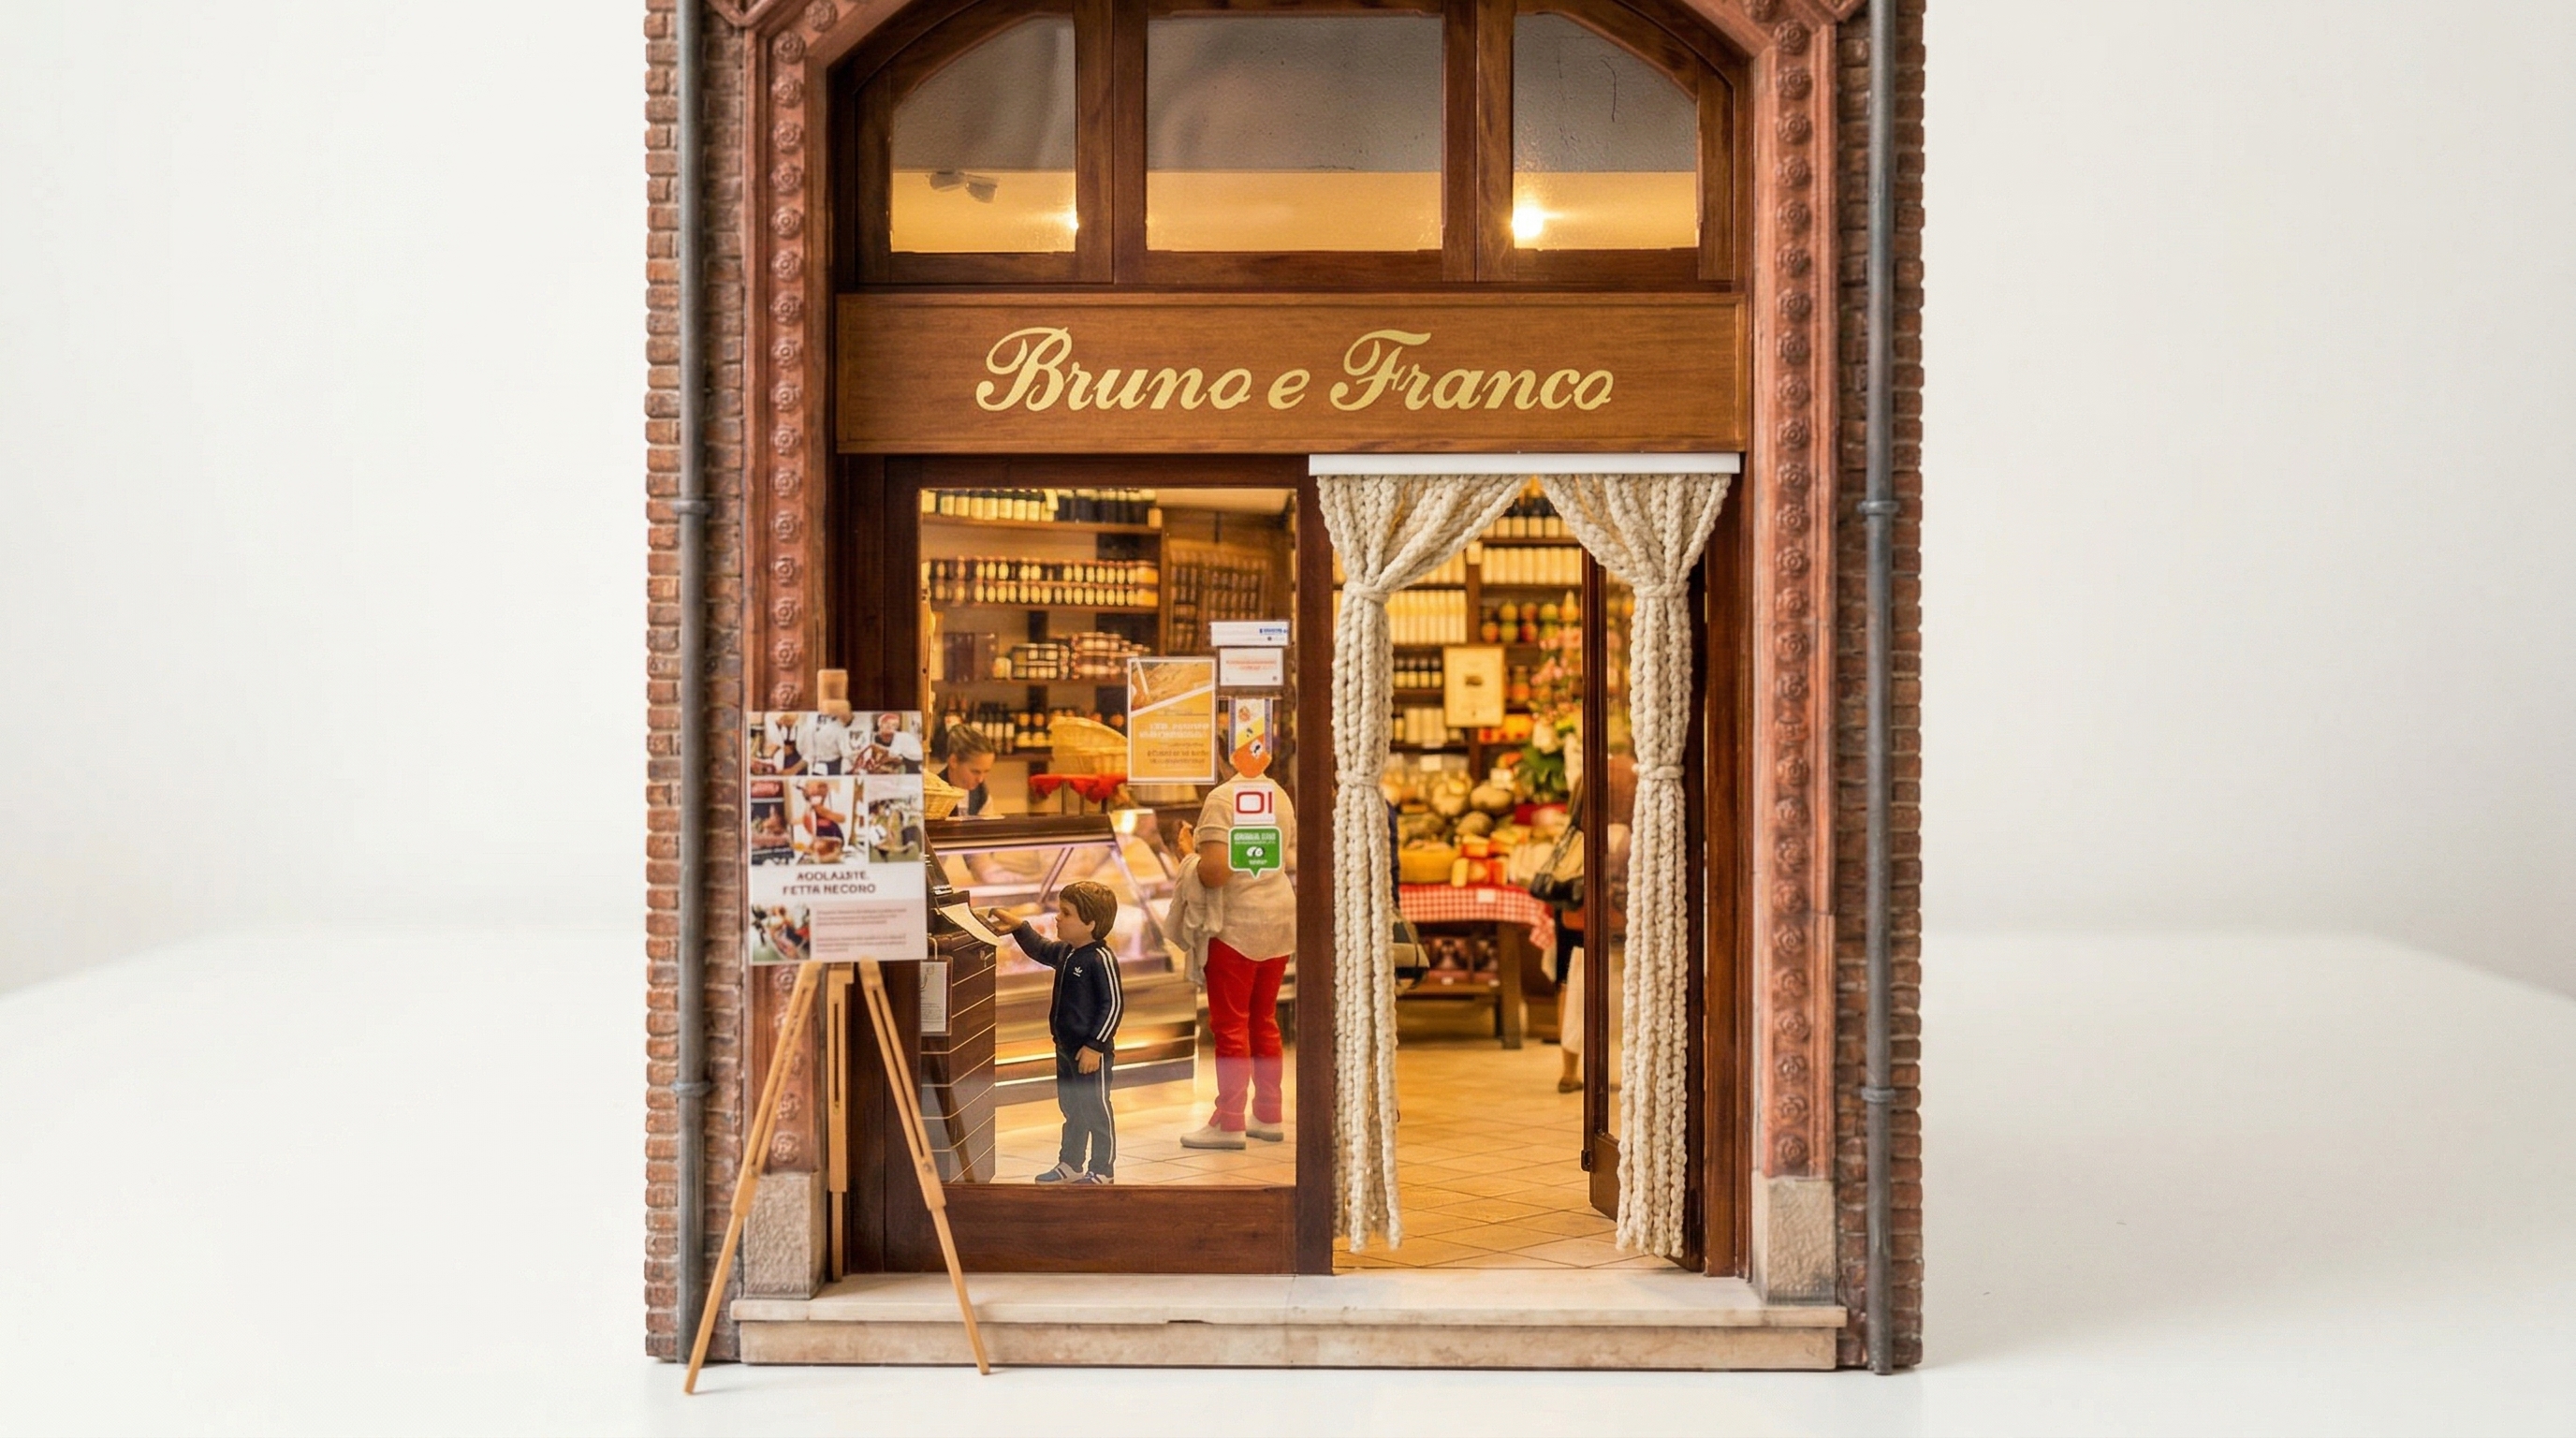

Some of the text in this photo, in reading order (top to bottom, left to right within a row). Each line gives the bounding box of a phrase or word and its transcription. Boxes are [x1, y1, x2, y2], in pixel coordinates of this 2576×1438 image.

[975, 327, 1615, 412] Bruno e Franco
